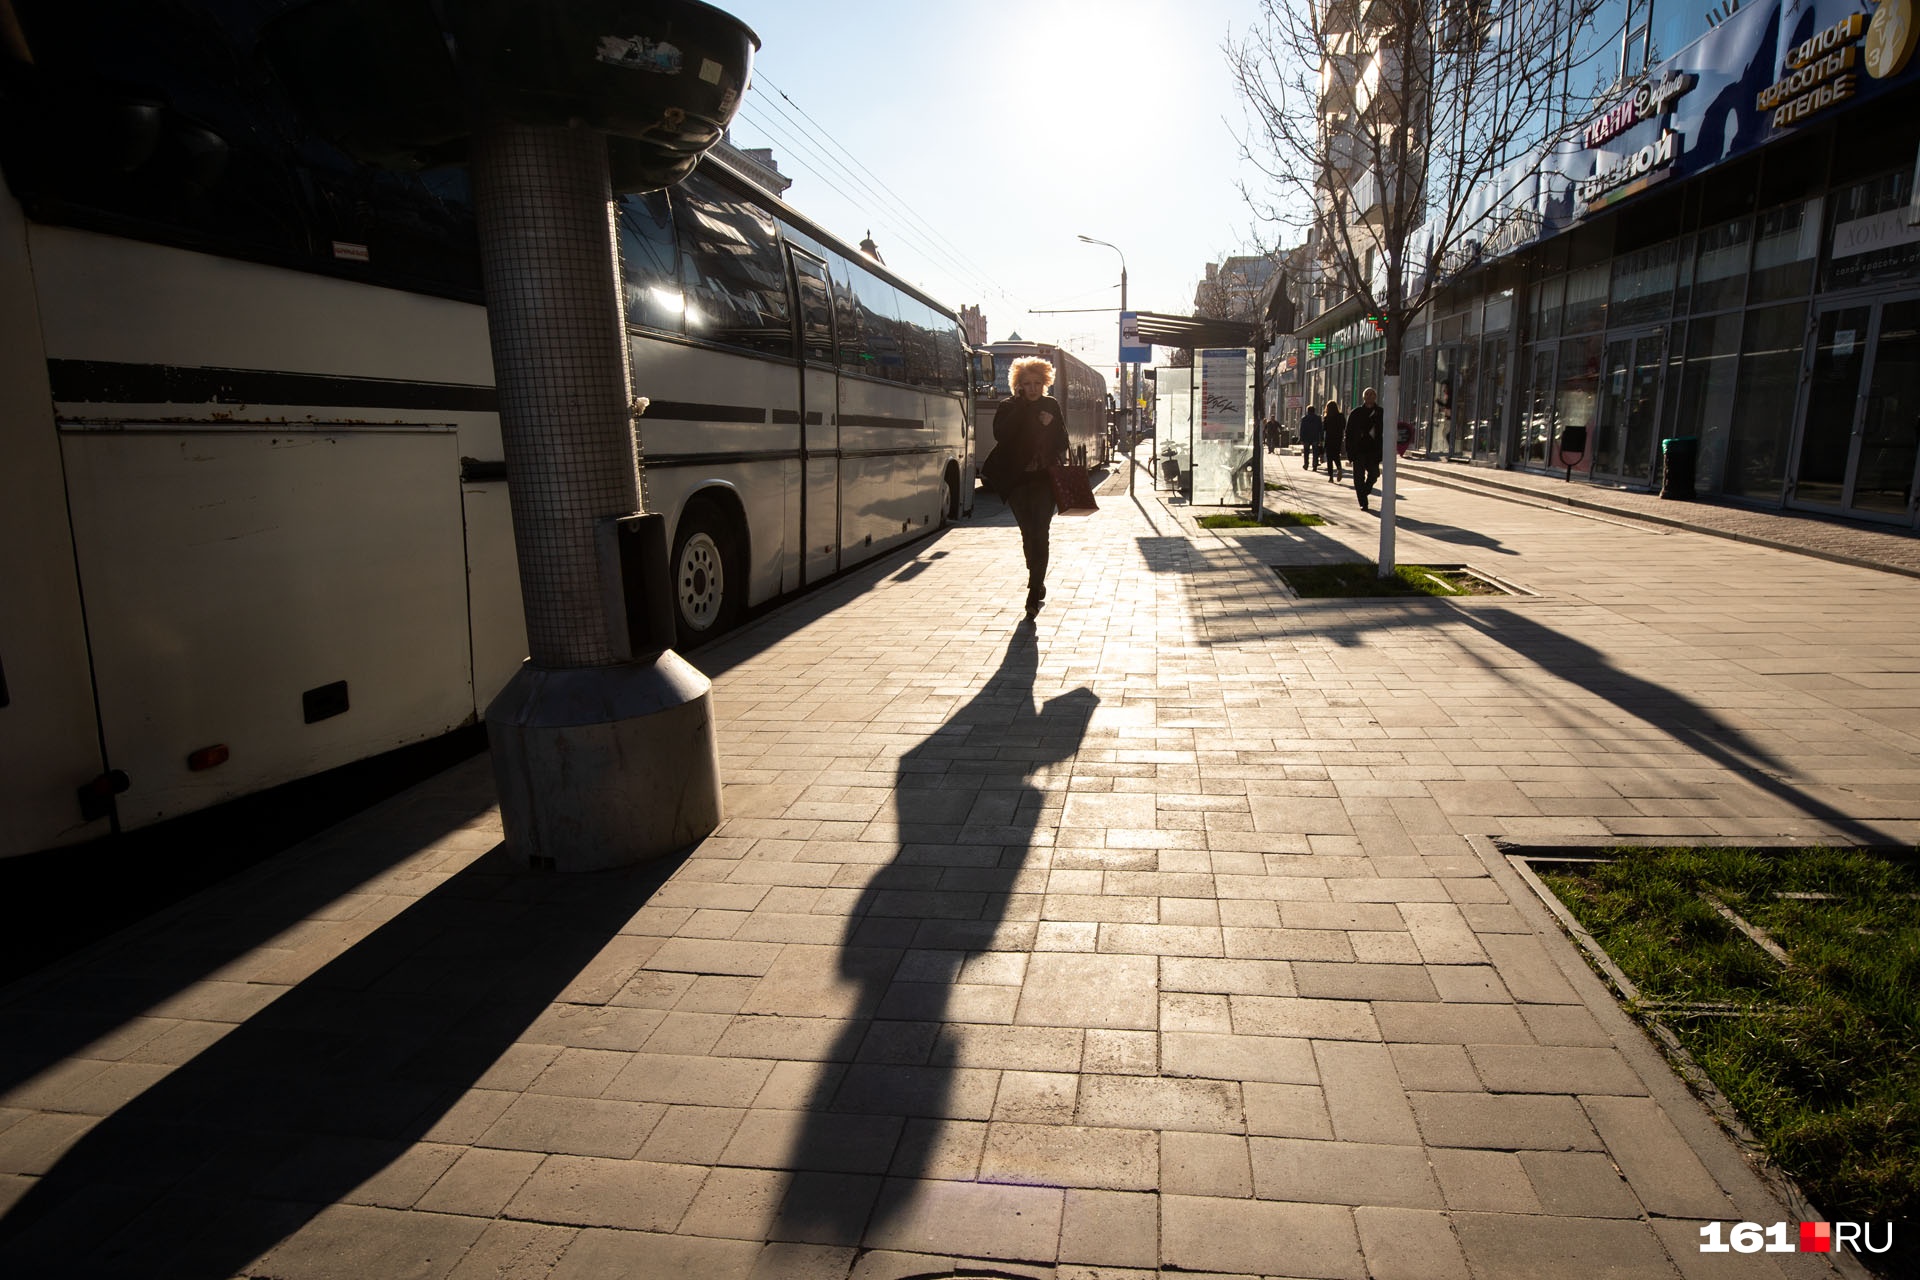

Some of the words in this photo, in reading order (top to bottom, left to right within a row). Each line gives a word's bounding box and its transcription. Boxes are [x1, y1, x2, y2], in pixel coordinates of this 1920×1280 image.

[1785, 14, 1852, 69] САЛОН
[1756, 47, 1845, 111] КРАСОТЫ
[1772, 74, 1848, 129] АТЕЛЬЕ
[1583, 100, 1633, 149] ТКАНИ
